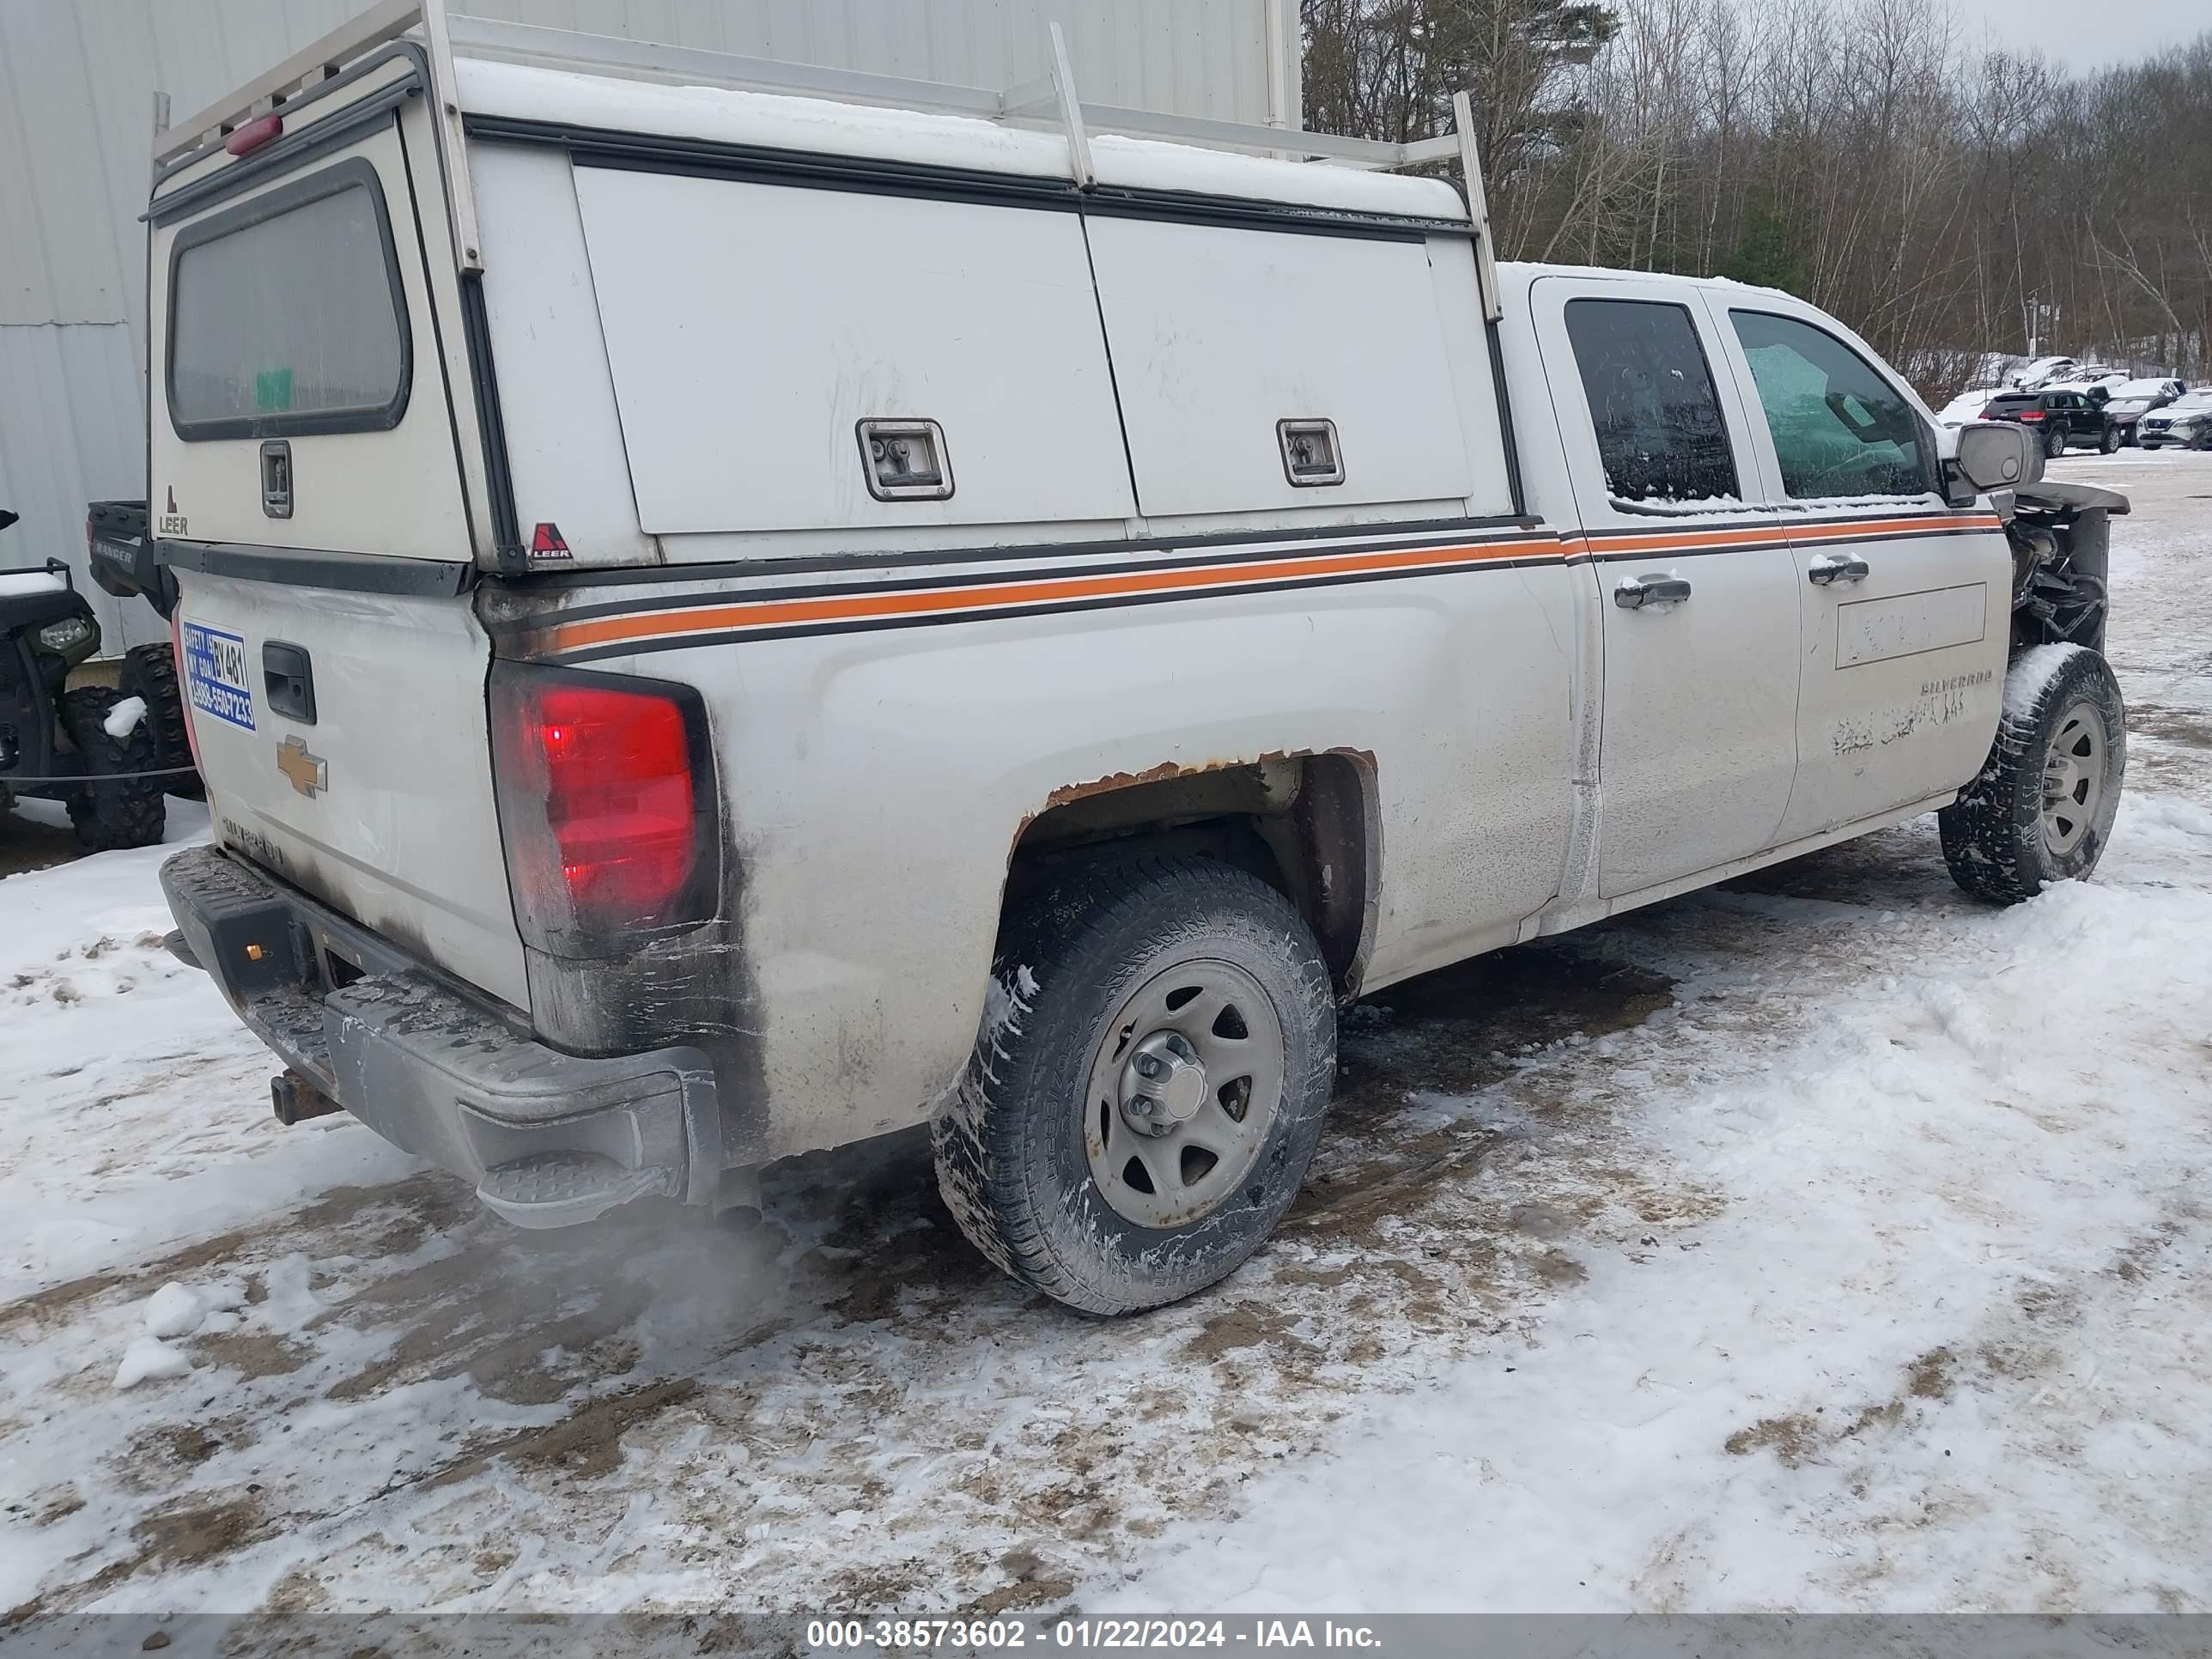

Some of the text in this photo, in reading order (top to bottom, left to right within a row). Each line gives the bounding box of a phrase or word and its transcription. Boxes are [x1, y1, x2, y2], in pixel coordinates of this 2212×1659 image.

[159, 515, 188, 536] LEER
[96, 543, 132, 563] RANGER
[185, 626, 214, 654] SAFETY IS
[187, 652, 216, 682] MY GOAL
[191, 678, 254, 726] 1-888-550-7233
